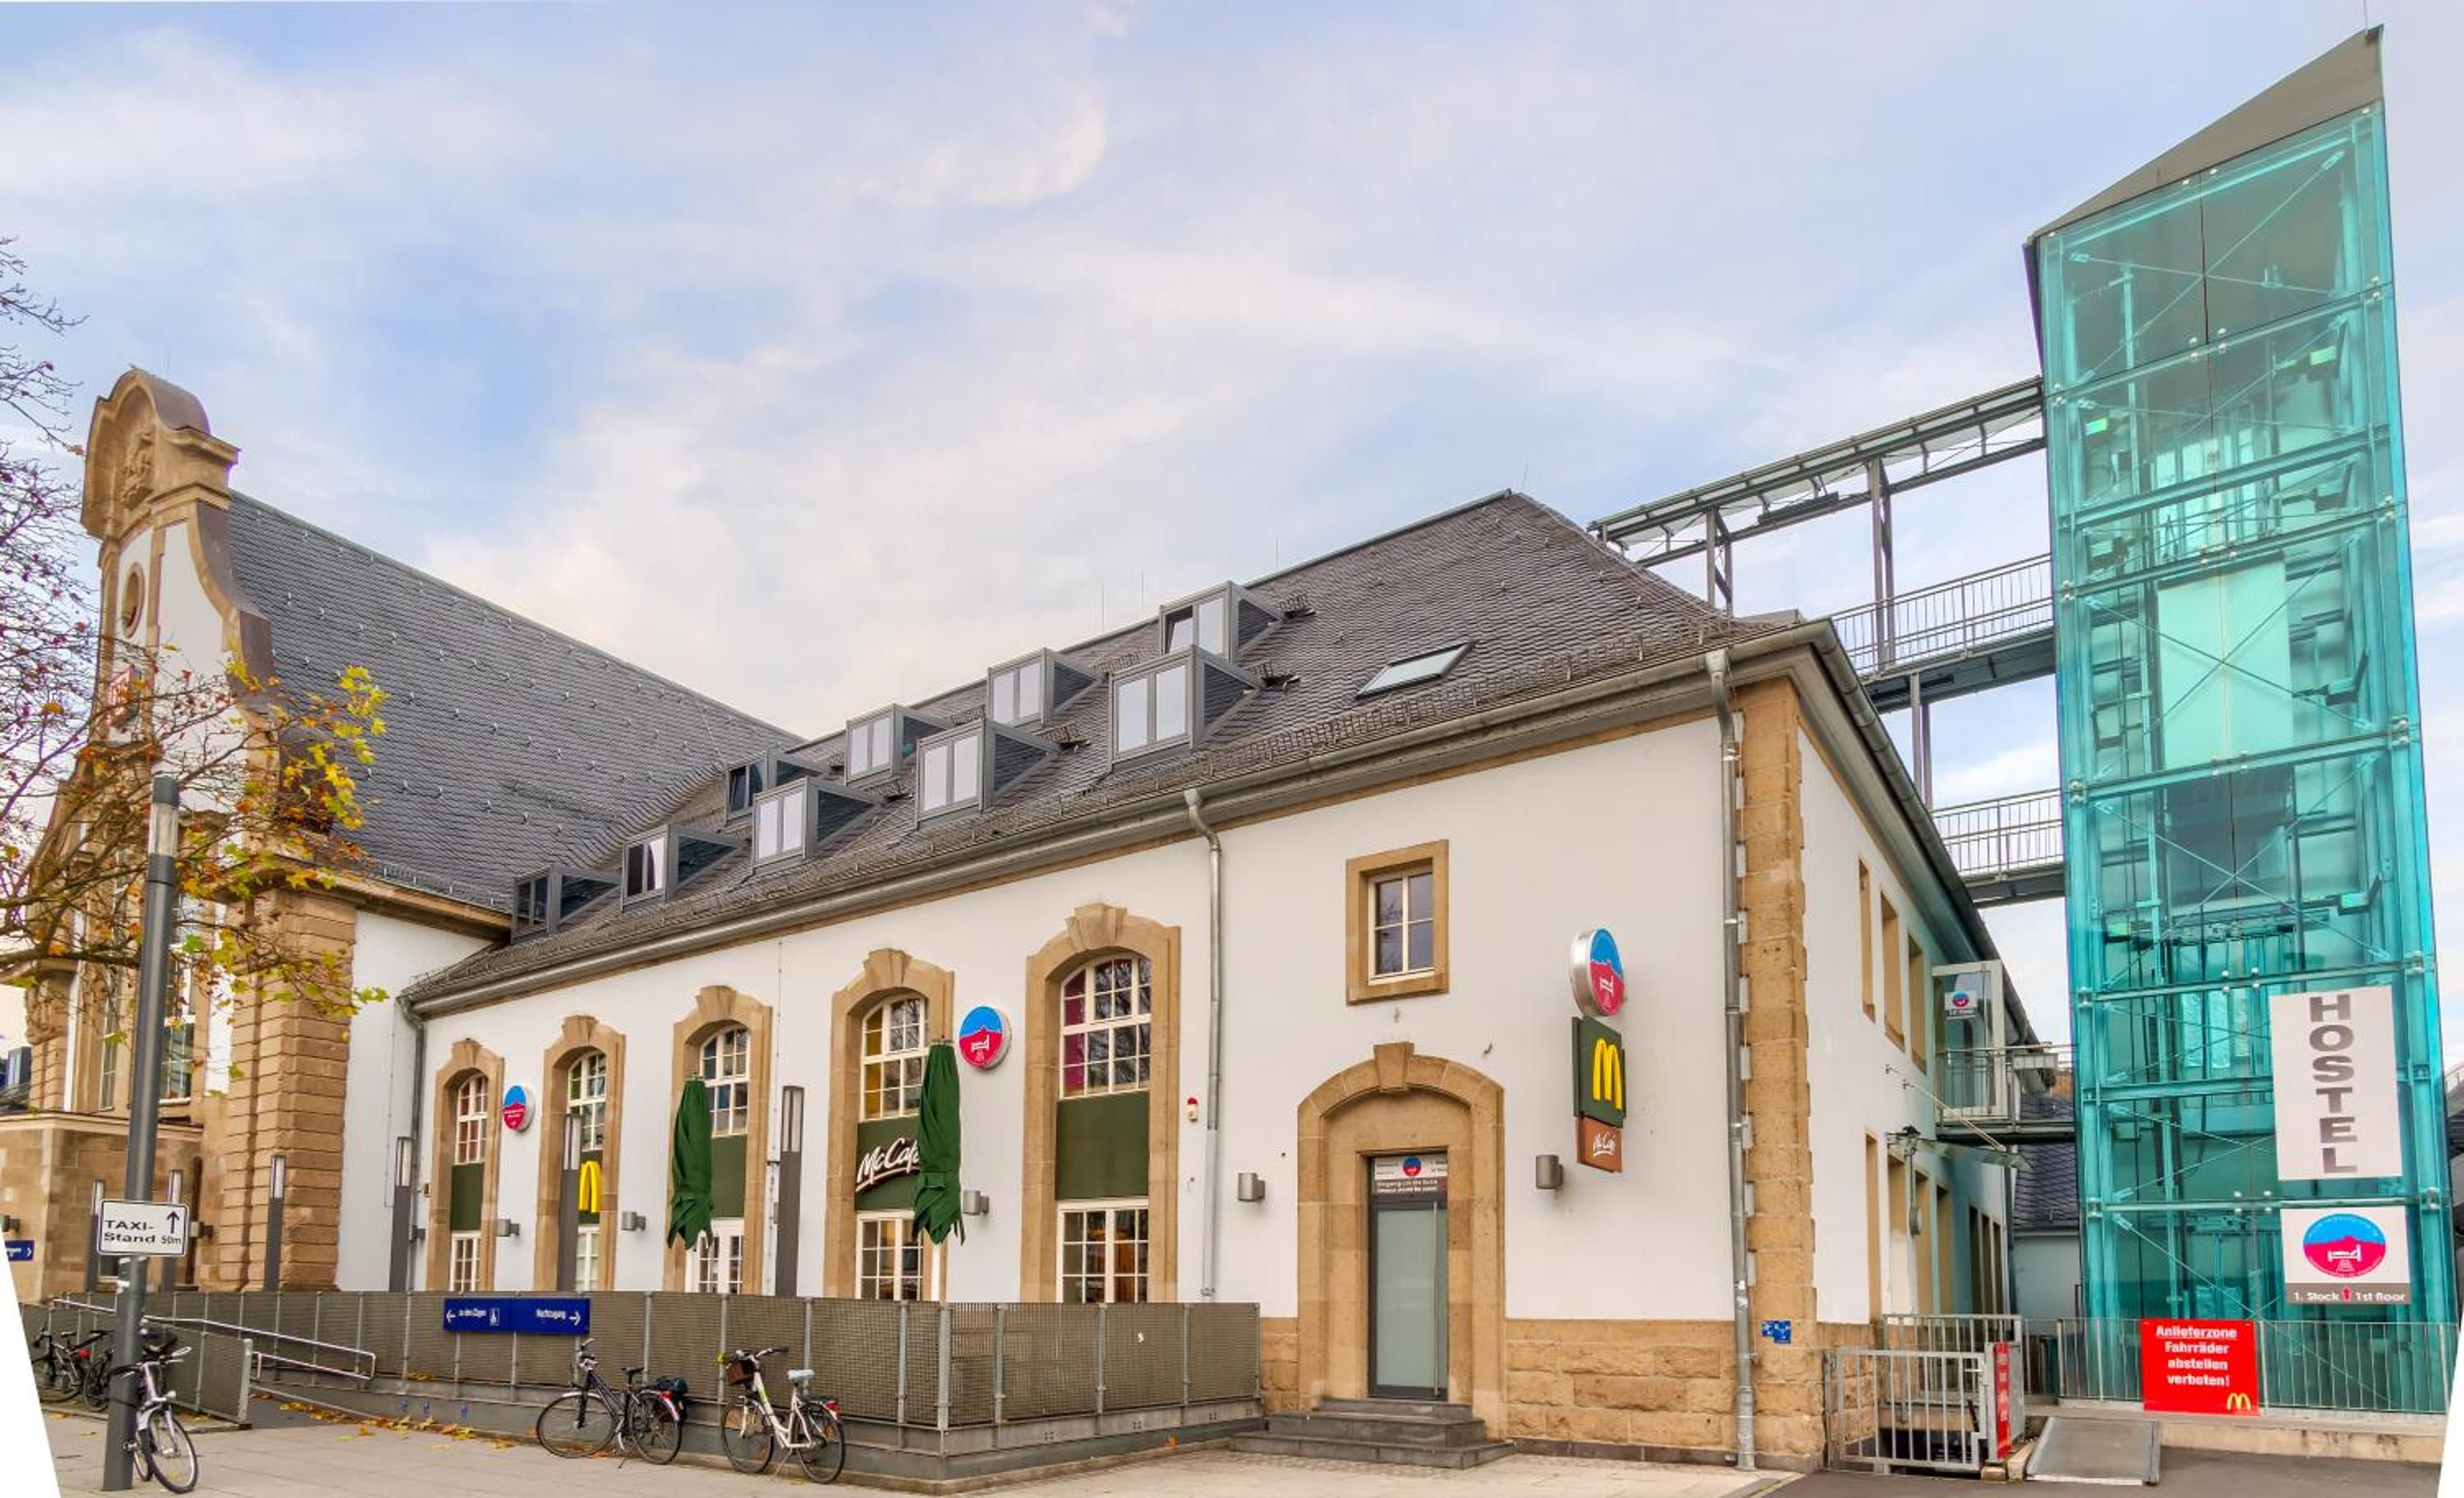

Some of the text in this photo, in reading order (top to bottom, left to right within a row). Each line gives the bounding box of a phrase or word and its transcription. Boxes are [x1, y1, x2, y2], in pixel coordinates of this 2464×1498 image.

[2309, 994, 2358, 1173] HOSTEL
[104, 1220, 154, 1231] TAXI-
[104, 1232, 182, 1245] Stand 50m
[2307, 1291, 2340, 1302] Stock
[2355, 1291, 2373, 1302] 1st
[2375, 1291, 2406, 1302] floor
[2156, 1326, 2237, 1339] Anlieferzone
[2164, 1341, 2229, 1353] Fahrräder
[2167, 1358, 2227, 1370] abstellen
[2167, 1374, 2230, 1386] verboten!
